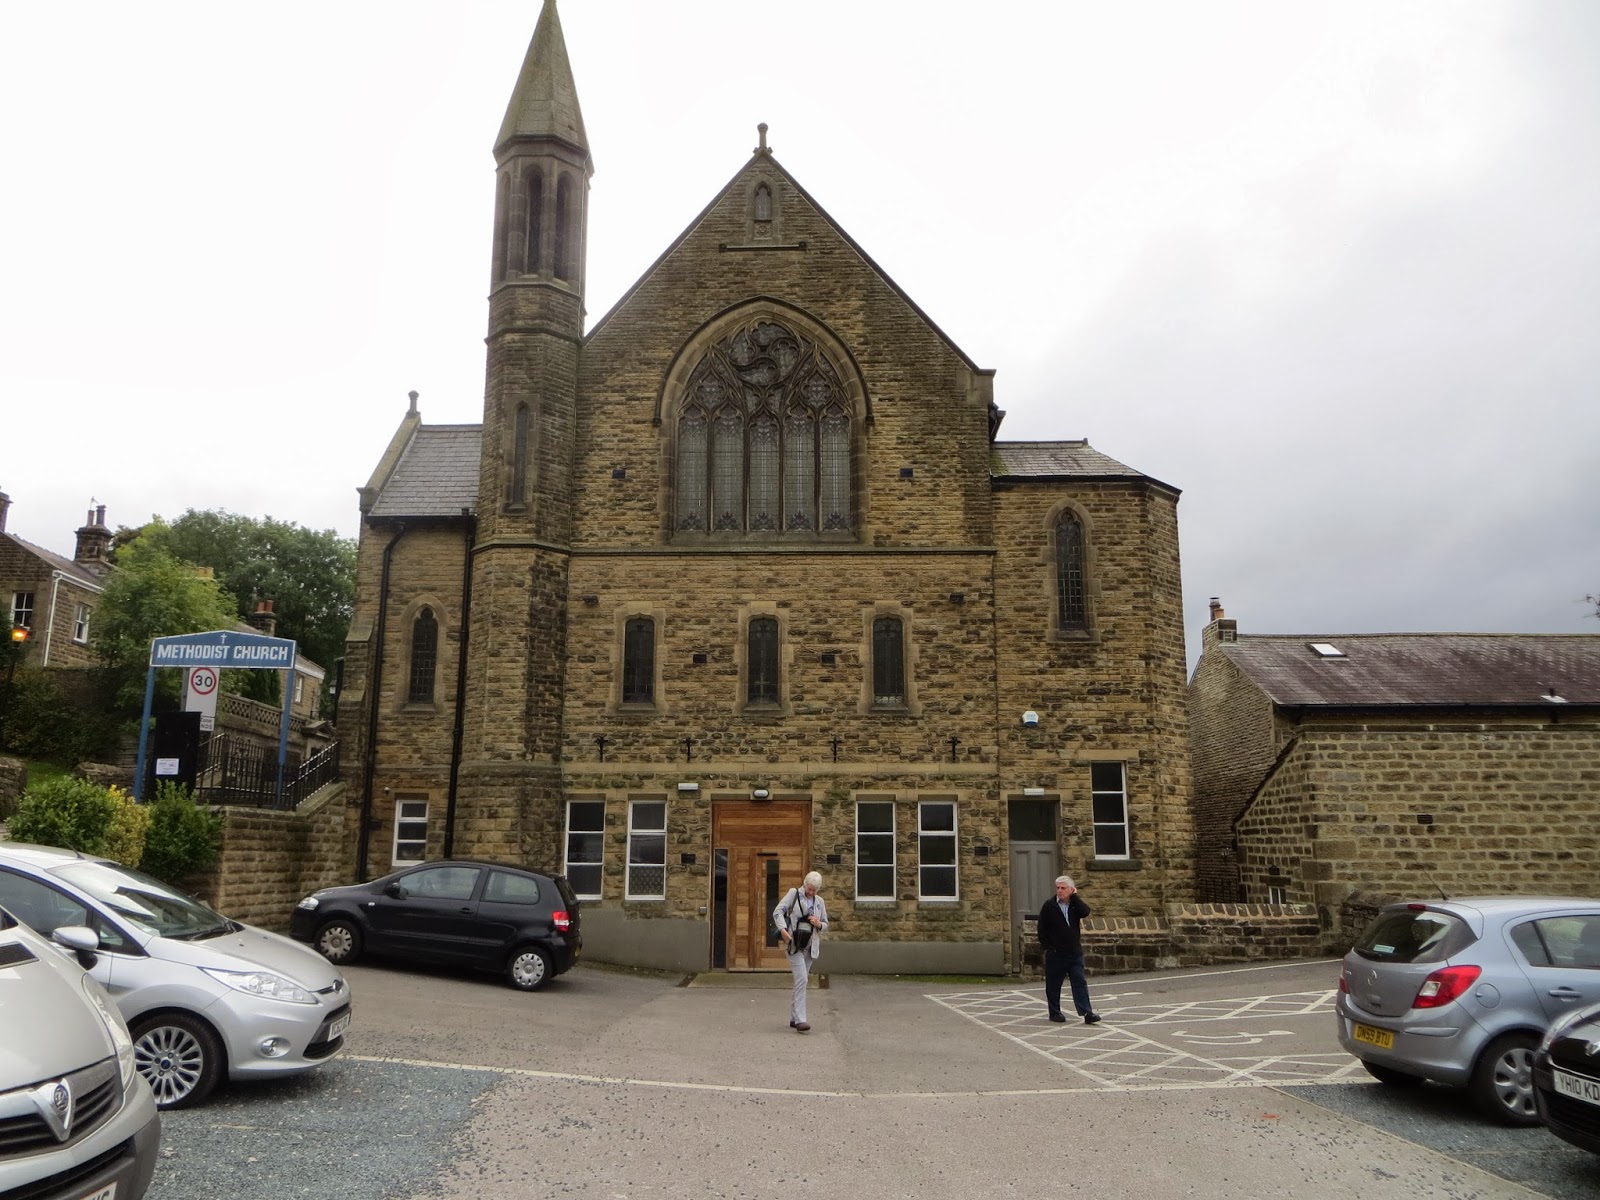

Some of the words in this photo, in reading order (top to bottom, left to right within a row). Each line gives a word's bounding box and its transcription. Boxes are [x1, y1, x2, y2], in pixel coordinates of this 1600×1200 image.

[157, 644, 230, 660] METHODIST
[233, 645, 288, 661] CHURCH
[194, 674, 213, 688] 30
[1356, 1025, 1376, 1041] DN59
[1584, 1081, 1600, 1101] KD
